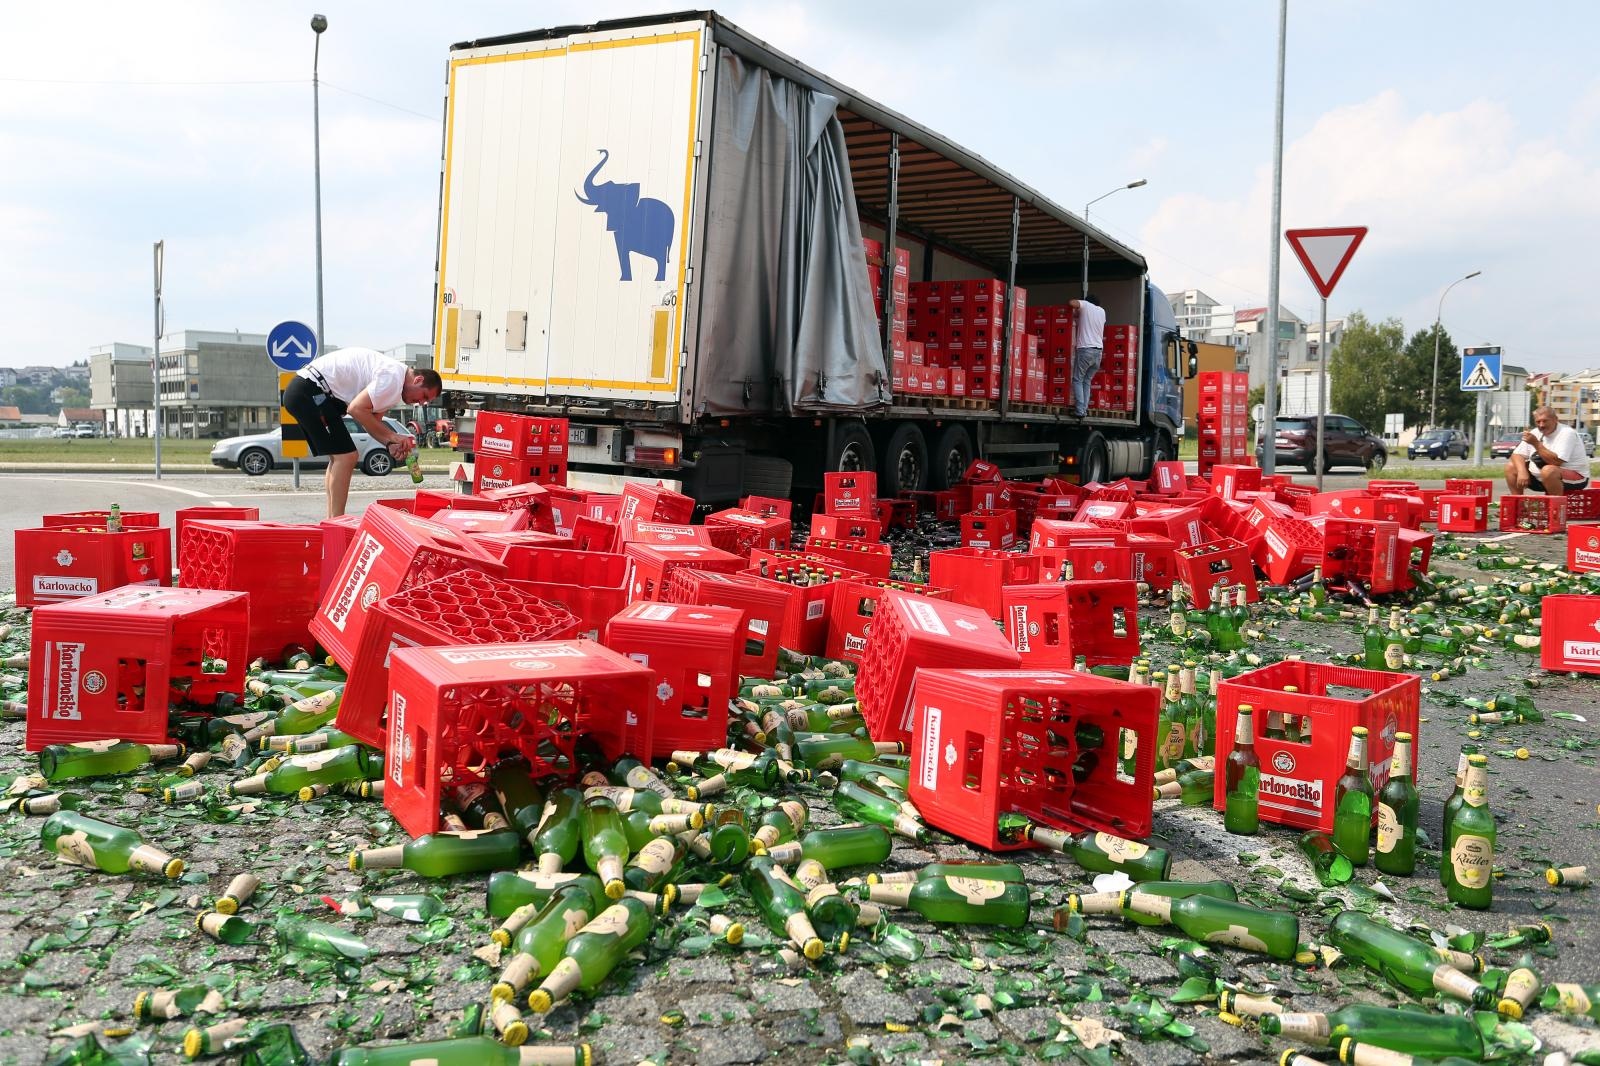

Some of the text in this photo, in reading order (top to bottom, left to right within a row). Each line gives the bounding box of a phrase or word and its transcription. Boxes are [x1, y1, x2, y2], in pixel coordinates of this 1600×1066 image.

[332, 540, 380, 623] Karlovačko
[60, 644, 79, 718] Karlovačko
[927, 714, 938, 782] Karlovačko
[1456, 852, 1489, 866] Radler
